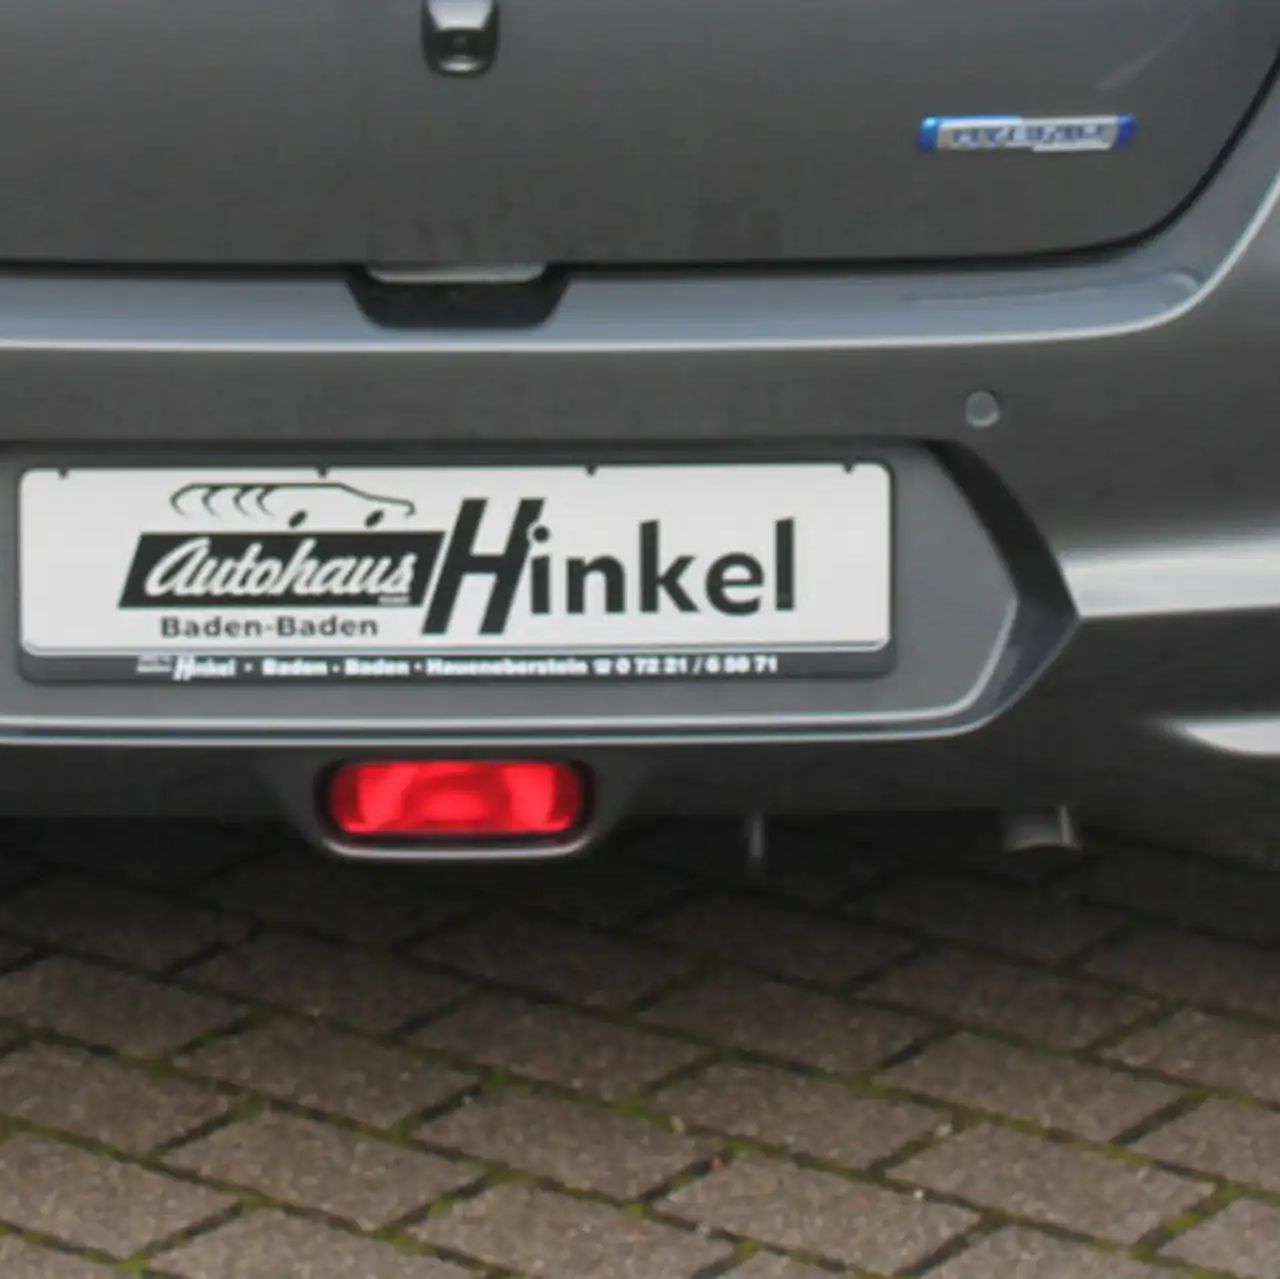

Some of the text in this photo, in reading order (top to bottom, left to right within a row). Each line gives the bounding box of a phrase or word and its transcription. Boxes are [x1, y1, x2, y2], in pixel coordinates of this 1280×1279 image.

[144, 497, 797, 636] Autohaus Hinkel
[160, 615, 378, 638] Baden-Baden
